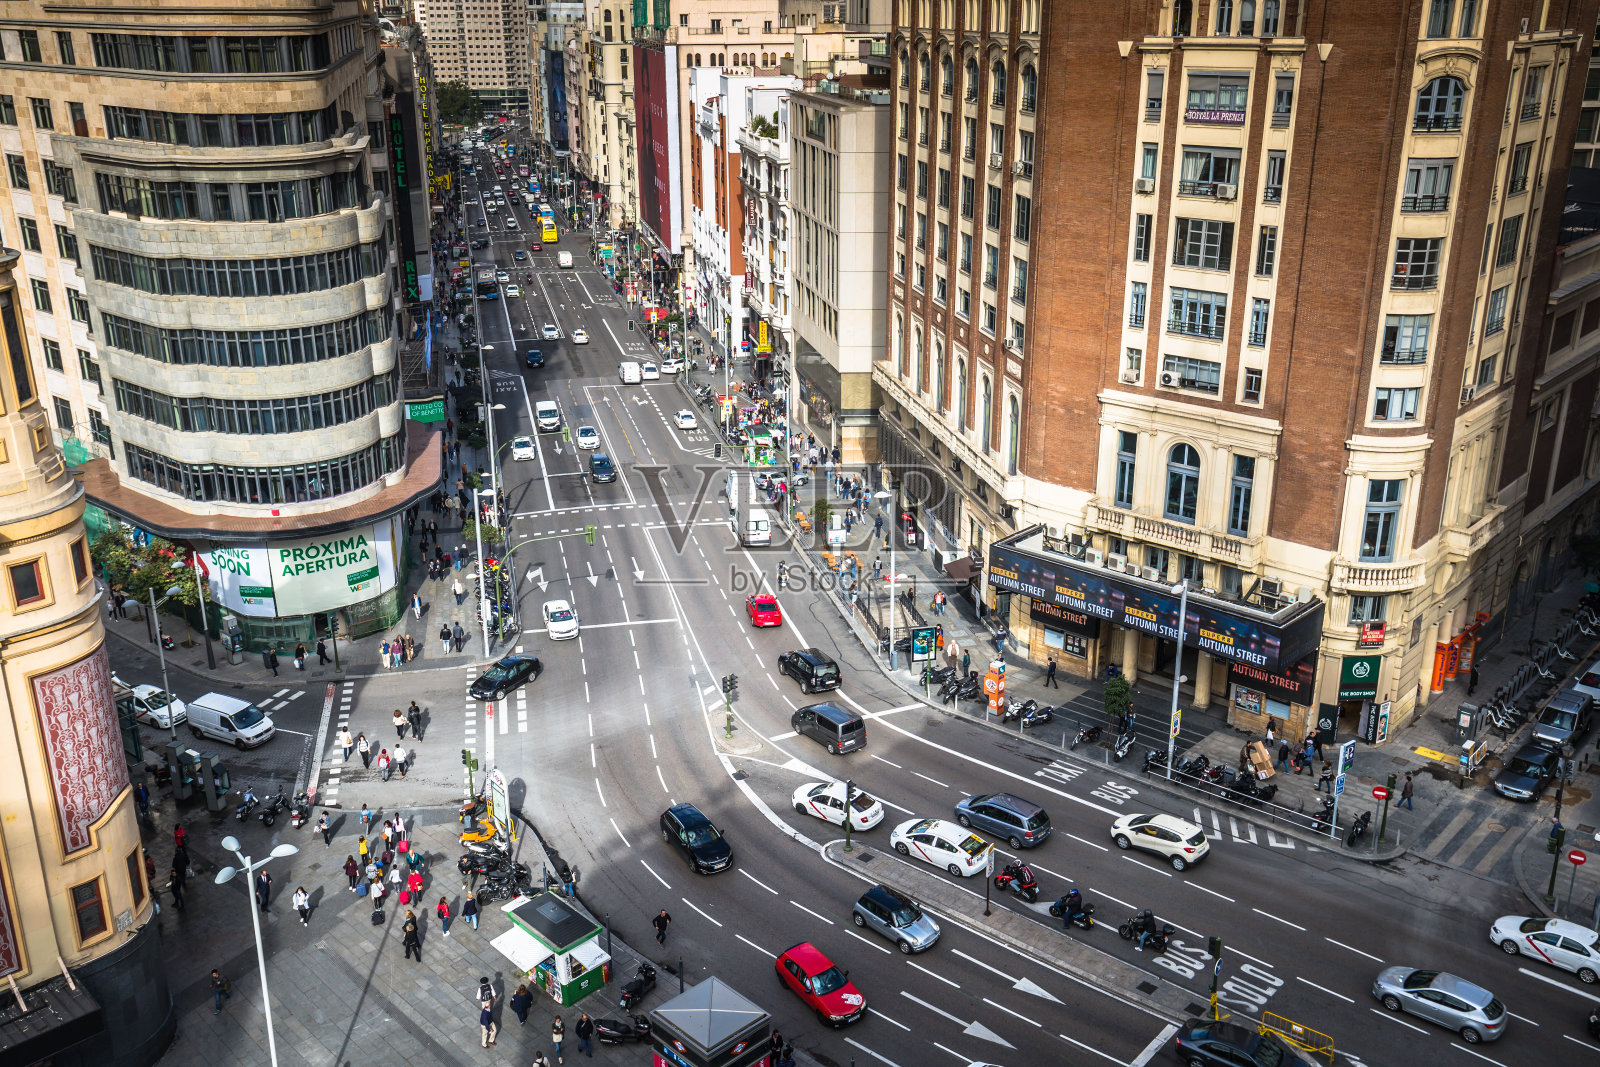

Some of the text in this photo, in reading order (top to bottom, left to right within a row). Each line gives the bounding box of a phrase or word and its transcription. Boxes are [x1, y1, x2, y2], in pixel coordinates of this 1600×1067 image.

[1211, 111, 1220, 120] LA
[1221, 112, 1245, 122] PRENSA
[420, 76, 435, 194] HOTEL EMPERADOR
[391, 119, 407, 188] HOTEL
[405, 260, 419, 299] REX
[209, 539, 250, 560] OPENING
[280, 534, 368, 563] PRÓXIMA
[211, 552, 251, 577] SOON
[282, 549, 370, 577] APERTURA
[989, 573, 1046, 598] AUTUMN STREET
[1032, 601, 1062, 617] AUTUMN
[1062, 610, 1088, 626] STREET
[1054, 593, 1087, 610] AUTUMN
[1087, 602, 1115, 619] STREET
[1124, 614, 1188, 641] AUTUMN STRET
[1198, 637, 1268, 666] AUTUMN STREET
[1232, 662, 1300, 692] AUTUMN STREET
[1034, 759, 1087, 784] TAXI
[1090, 781, 1139, 805] BUS
[1152, 940, 1213, 979] BUS
[1216, 963, 1285, 1013] SOLO
